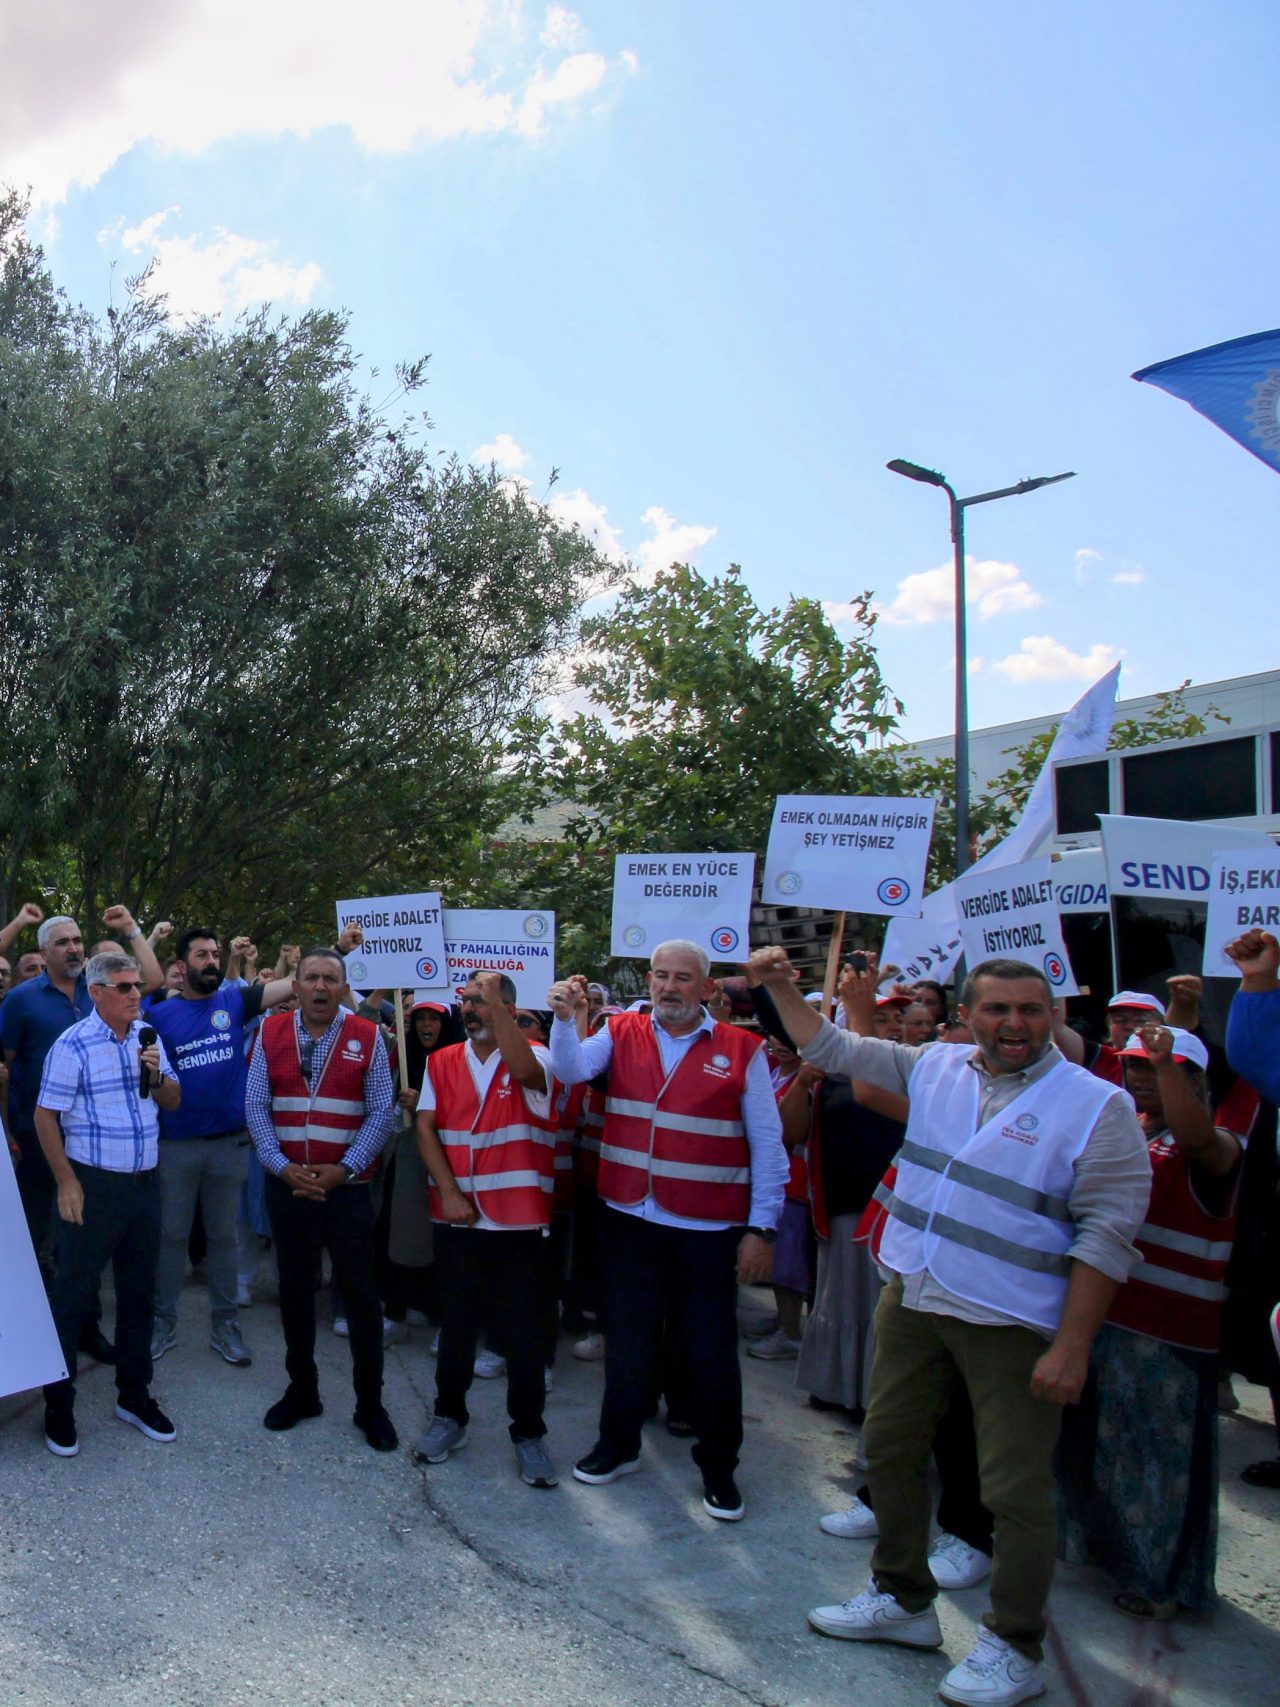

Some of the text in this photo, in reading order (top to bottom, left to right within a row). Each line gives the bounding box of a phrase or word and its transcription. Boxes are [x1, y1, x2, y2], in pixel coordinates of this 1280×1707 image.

[780, 811, 928, 832] EMEK OLMADAN HİÇBİR
[804, 831, 895, 851] ŞEY YETİŞMEZ
[628, 860, 738, 876] EMEK EN YÜCE
[644, 881, 718, 898] DEĞERDİR
[961, 879, 1054, 919] VERGİDE ADALET
[393, 908, 439, 927] ADALET
[983, 923, 1046, 953] İSTİYORUZ
[461, 943, 549, 957] PAHALILIĞINA
[446, 957, 524, 971] OKSULLUĞA
[177, 1046, 234, 1071] SENDİKASI
